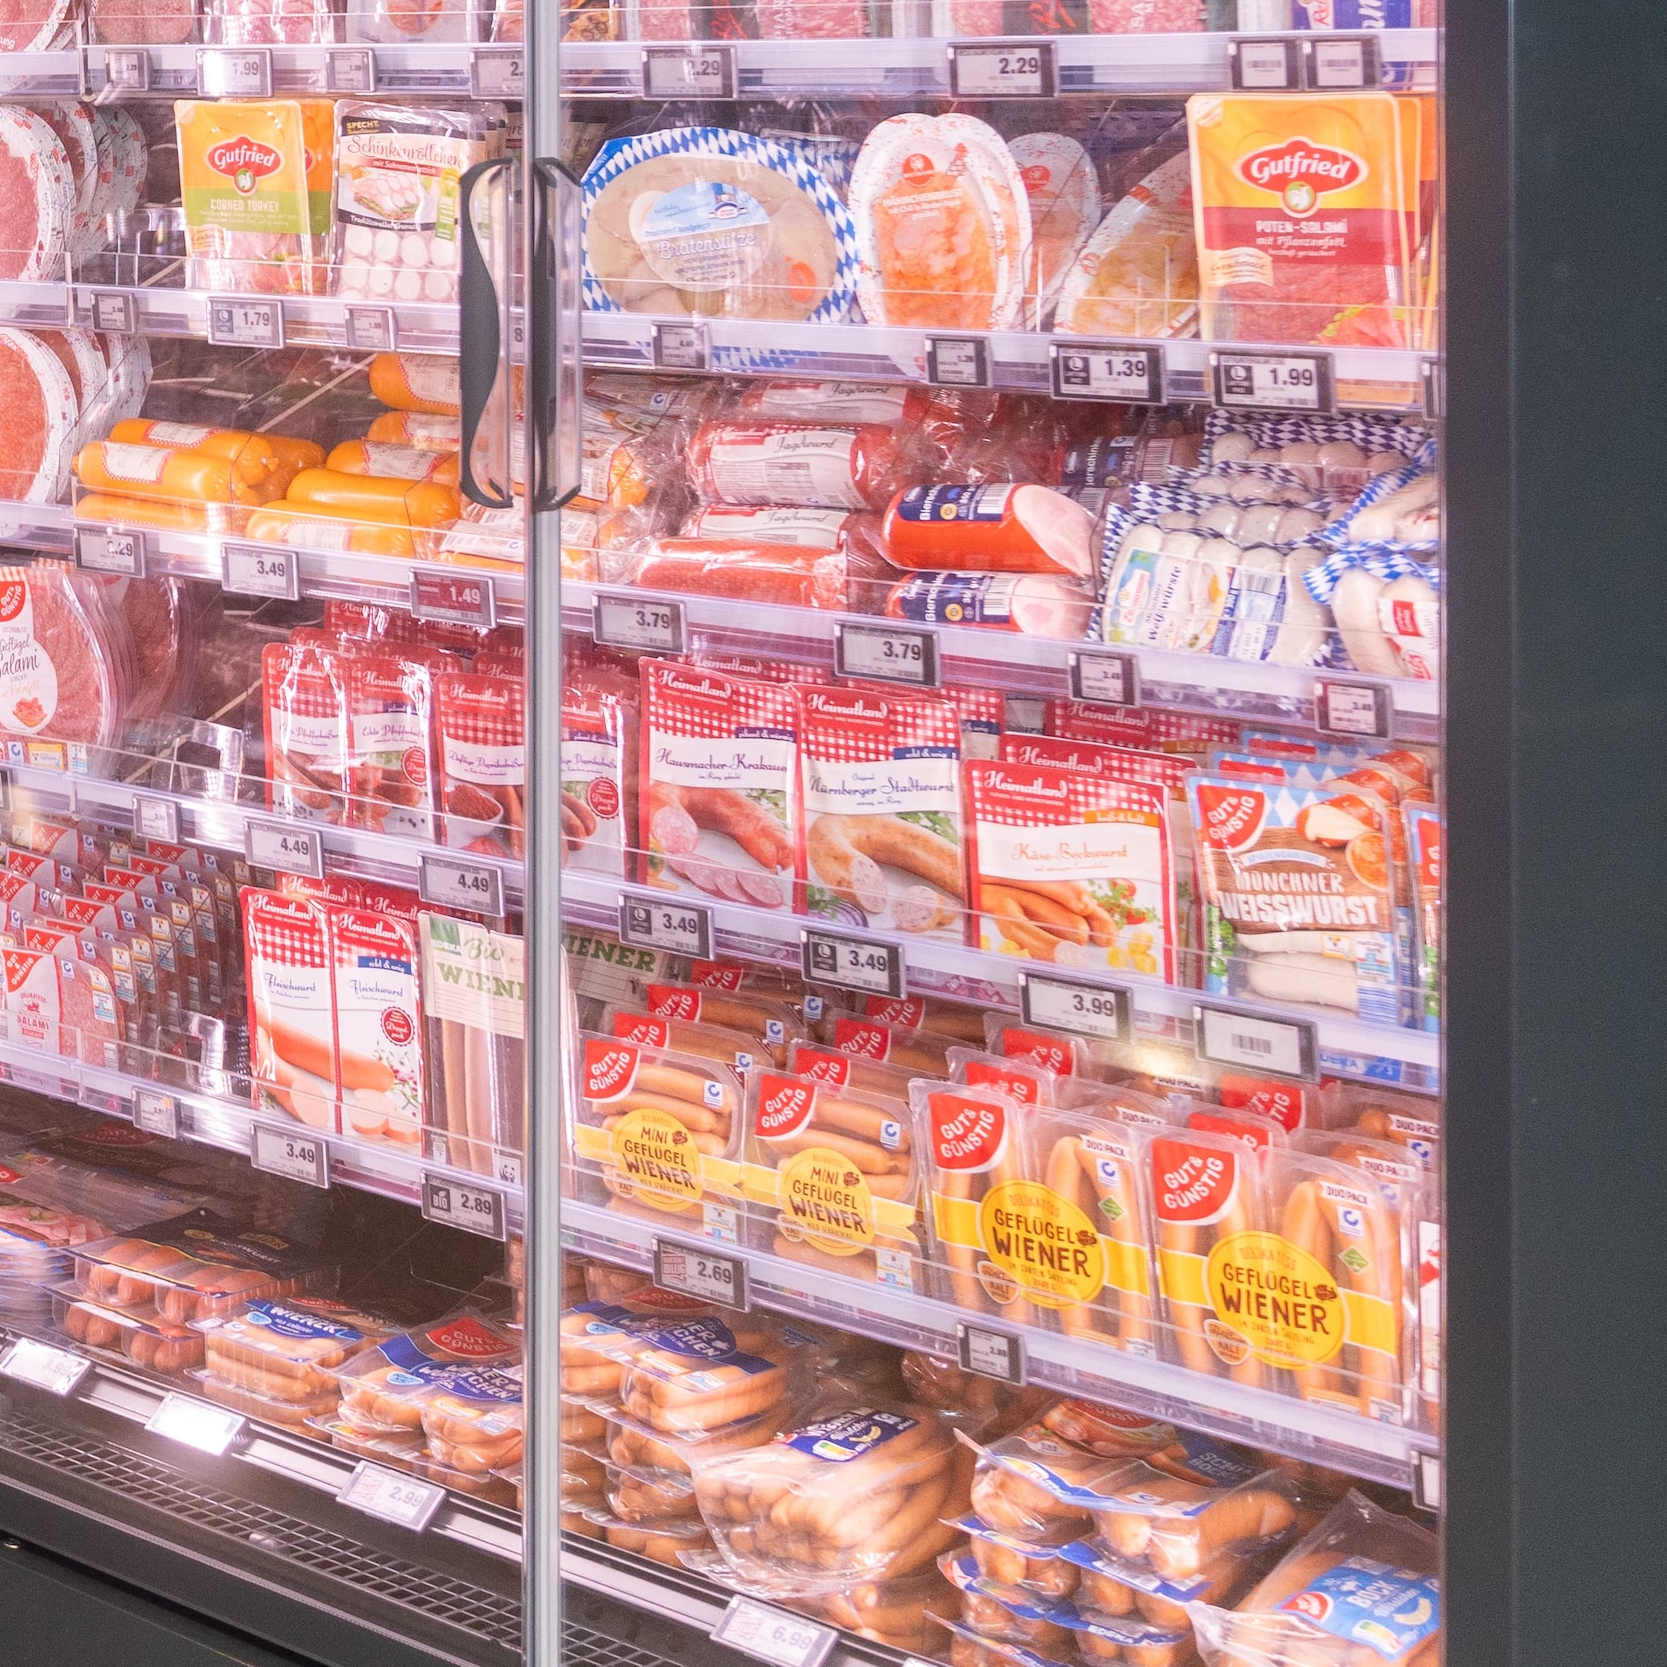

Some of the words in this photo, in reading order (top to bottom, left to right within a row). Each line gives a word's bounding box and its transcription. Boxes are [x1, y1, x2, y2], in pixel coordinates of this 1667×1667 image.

[998, 57, 1038, 74] 2.29
[346, 121, 379, 130] SPECHT
[213, 145, 276, 170] Gutfried
[348, 136, 464, 170] Schinkenröllchen
[1250, 146, 1352, 183] Gutfried
[210, 198, 245, 212] CORNED
[248, 199, 280, 213] TURKEY
[658, 232, 755, 260] Bratensülze
[243, 311, 270, 326] 1.79
[1104, 359, 1146, 378] 1.39
[1270, 368, 1314, 388] 1.99
[257, 560, 285, 577] 3.49
[1, 584, 22, 617] GÜNSTIG
[449, 586, 481, 605] 1.49
[636, 611, 671, 629] 3.79
[0, 634, 30, 655] Geflügel
[883, 641, 921, 661] 3.79
[450, 683, 509, 703] Heimatland
[658, 670, 733, 698] Heimatland
[808, 693, 889, 719] Heimatland
[1067, 702, 1152, 728] Heimatland
[657, 748, 788, 774] Hausmacher-Krakauer
[1018, 745, 1103, 773] Heimatland
[810, 776, 878, 797] Nürnberger
[879, 775, 955, 796] Stadtwurst
[984, 769, 1069, 800] Heimatland
[1209, 796, 1256, 841] GÜNSTIG
[281, 839, 309, 856] 4.49
[1011, 840, 1128, 864] Käse-Bockwurst
[288, 876, 348, 904] Heimatland
[458, 874, 489, 893] 4.49
[1235, 871, 1344, 894] MÜNCHNER
[254, 894, 315, 920] Heimatland
[1217, 890, 1378, 926] WEISSWURST
[339, 914, 401, 941] Heimatland
[663, 913, 697, 933] 3.49
[464, 939, 505, 962] Bio
[849, 950, 887, 972] 3.49
[264, 972, 316, 994] Fleischwurst
[349, 979, 404, 999] Fleischwurst
[1073, 994, 1114, 1016] 3.99
[16, 1014, 49, 1031] SALAMI
[589, 1052, 630, 1092] GÜNSTIG
[762, 1087, 806, 1128] GÜNSTIG
[641, 1127, 668, 1143] MINI
[940, 1110, 995, 1158] GÜNSTIG
[286, 1143, 315, 1163] 3.49
[625, 1139, 686, 1167] GEFLÜGEL
[1085, 1139, 1104, 1153] DUO
[1105, 1143, 1126, 1157] PACK
[623, 1152, 696, 1191] WIENER
[811, 1166, 839, 1186] MINI
[1163, 1155, 1225, 1210] GÜNSTIG
[433, 1193, 449, 1208] BIO
[461, 1196, 492, 1216] 2.89
[793, 1181, 858, 1210] GEFLÜGEL
[1327, 1186, 1345, 1200] DUO
[1346, 1190, 1368, 1205] PACK
[790, 1195, 866, 1235] WIENER
[994, 1208, 1076, 1245] GEFLÜGEL
[992, 1226, 1092, 1279] WIENER
[697, 1260, 732, 1284] 2.69
[1223, 1262, 1312, 1300] GEFLÜGEL
[270, 1305, 343, 1334] WIENER
[1220, 1283, 1331, 1336] WIENER
[441, 1334, 510, 1353] GÜNSTIG
[389, 1485, 424, 1508] 2.99
[1346, 1577, 1400, 1608] BOCK
[772, 1625, 813, 1651] 6.99
[1088, 1624, 1134, 1644] EDEKA
